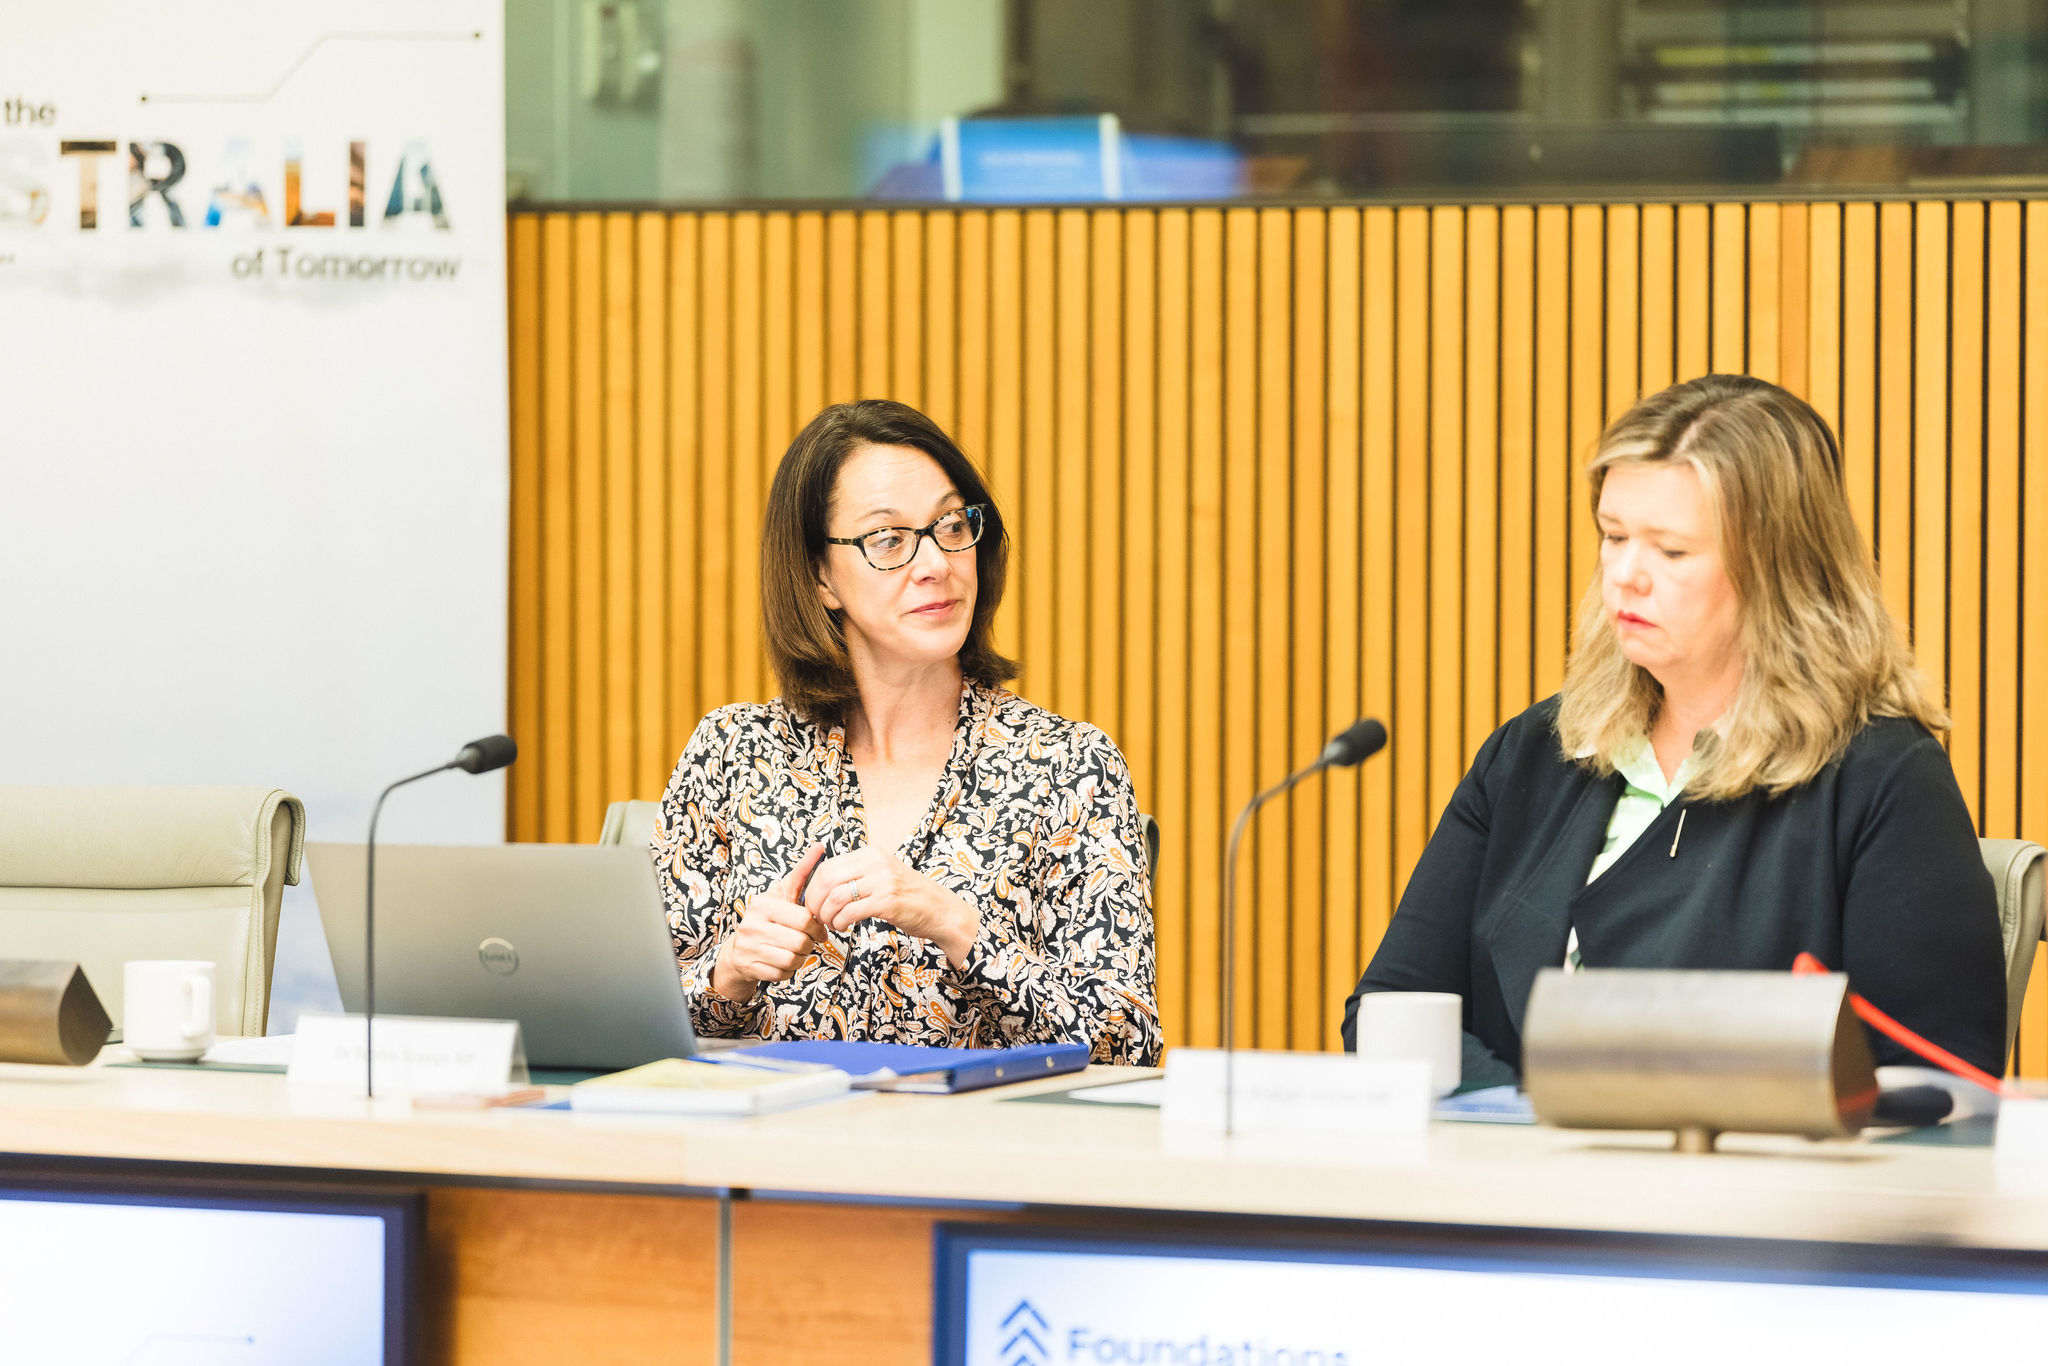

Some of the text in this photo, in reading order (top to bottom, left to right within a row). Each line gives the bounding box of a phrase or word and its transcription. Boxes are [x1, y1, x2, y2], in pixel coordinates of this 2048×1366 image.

[5, 98, 56, 126] the
[232, 249, 461, 281] of Tomorrow
